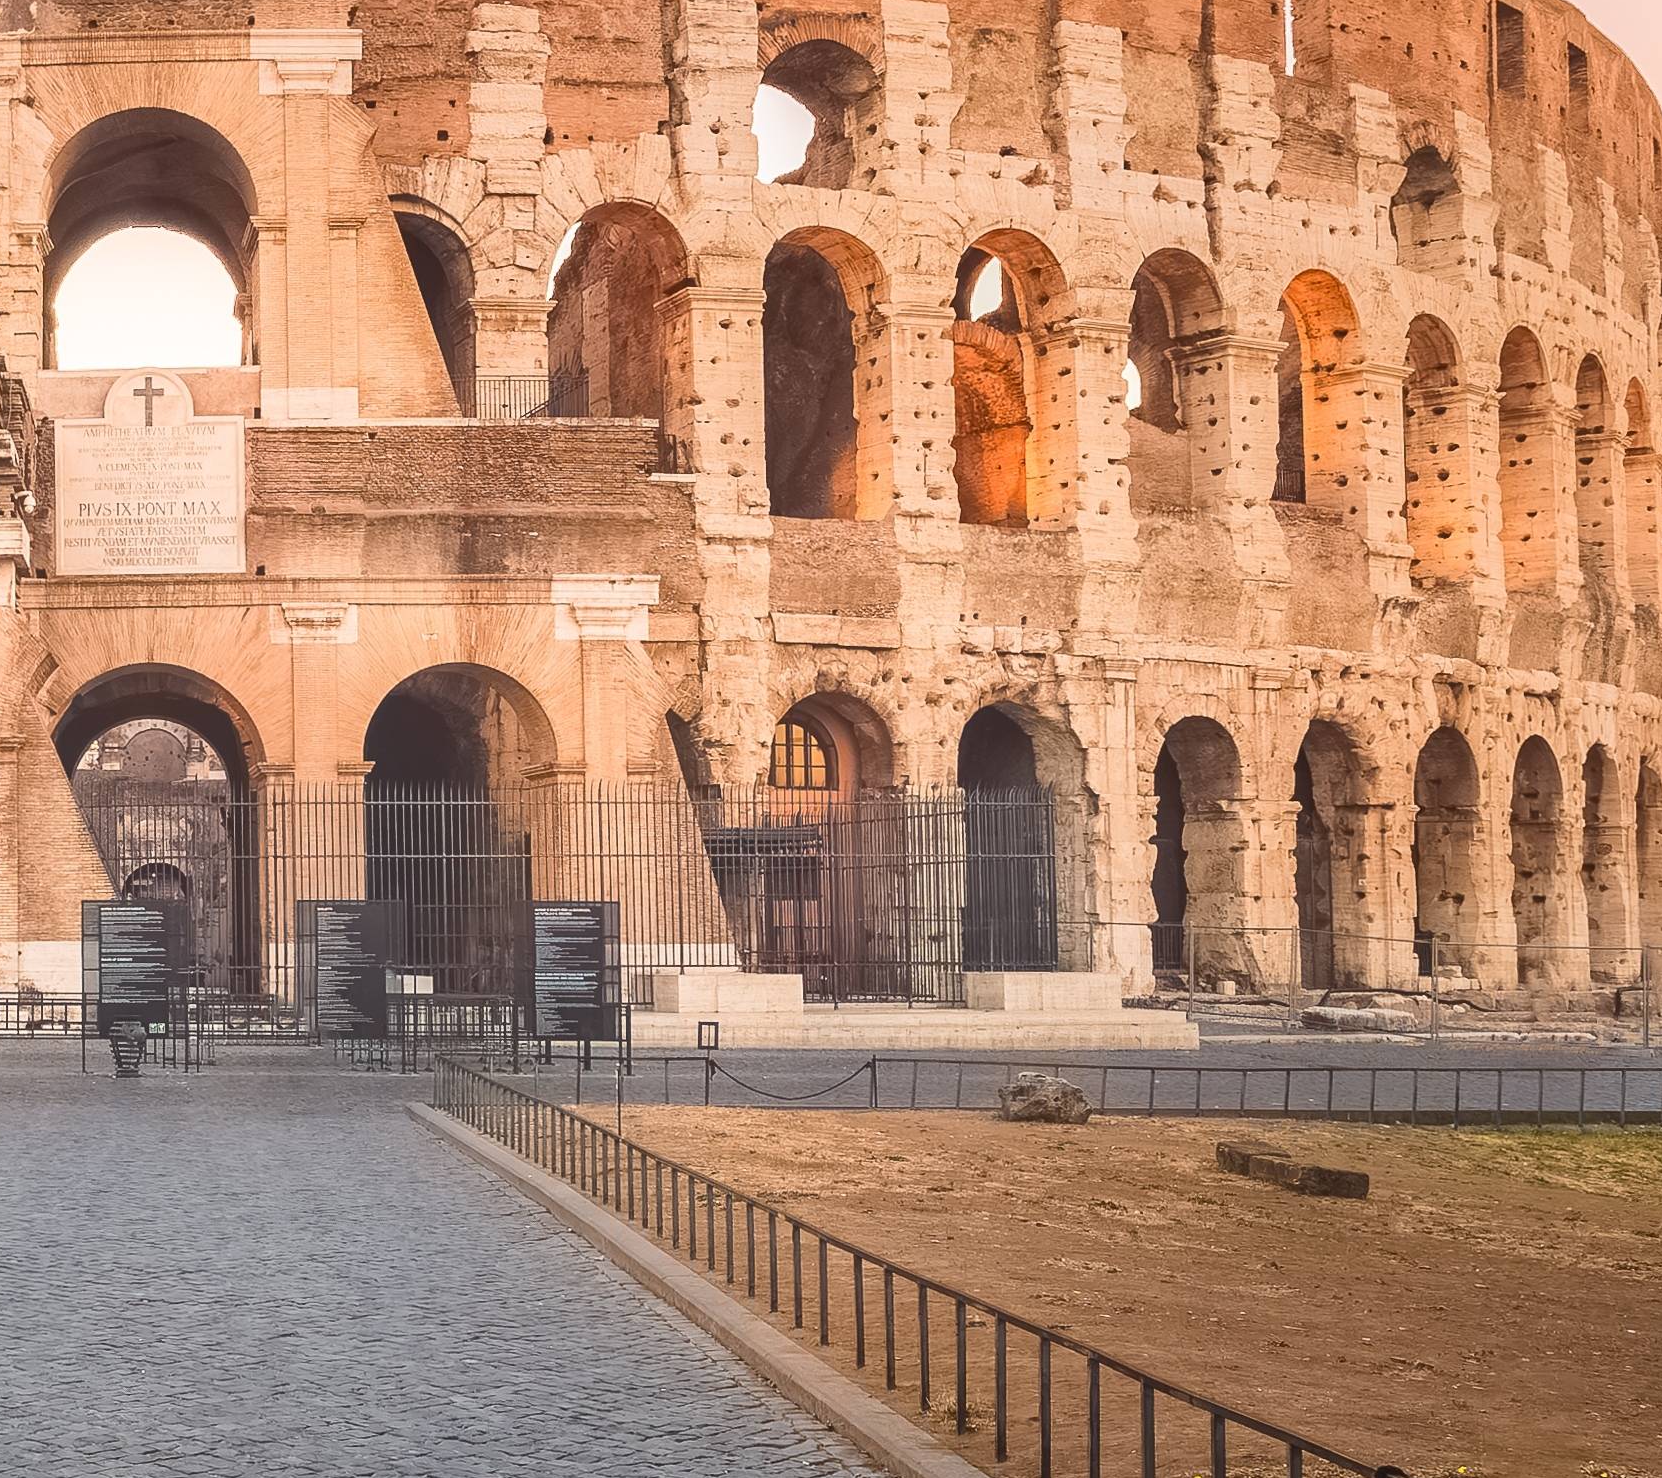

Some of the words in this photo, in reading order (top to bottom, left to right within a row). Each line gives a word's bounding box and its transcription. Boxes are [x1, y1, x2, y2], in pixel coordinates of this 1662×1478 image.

[105, 463, 148, 472] CLEMENTE
[183, 462, 203, 471] MAX
[79, 503, 112, 517] PIVS
[116, 502, 132, 516] IX
[137, 501, 177, 516] PONT
[183, 501, 221, 515] MAX
